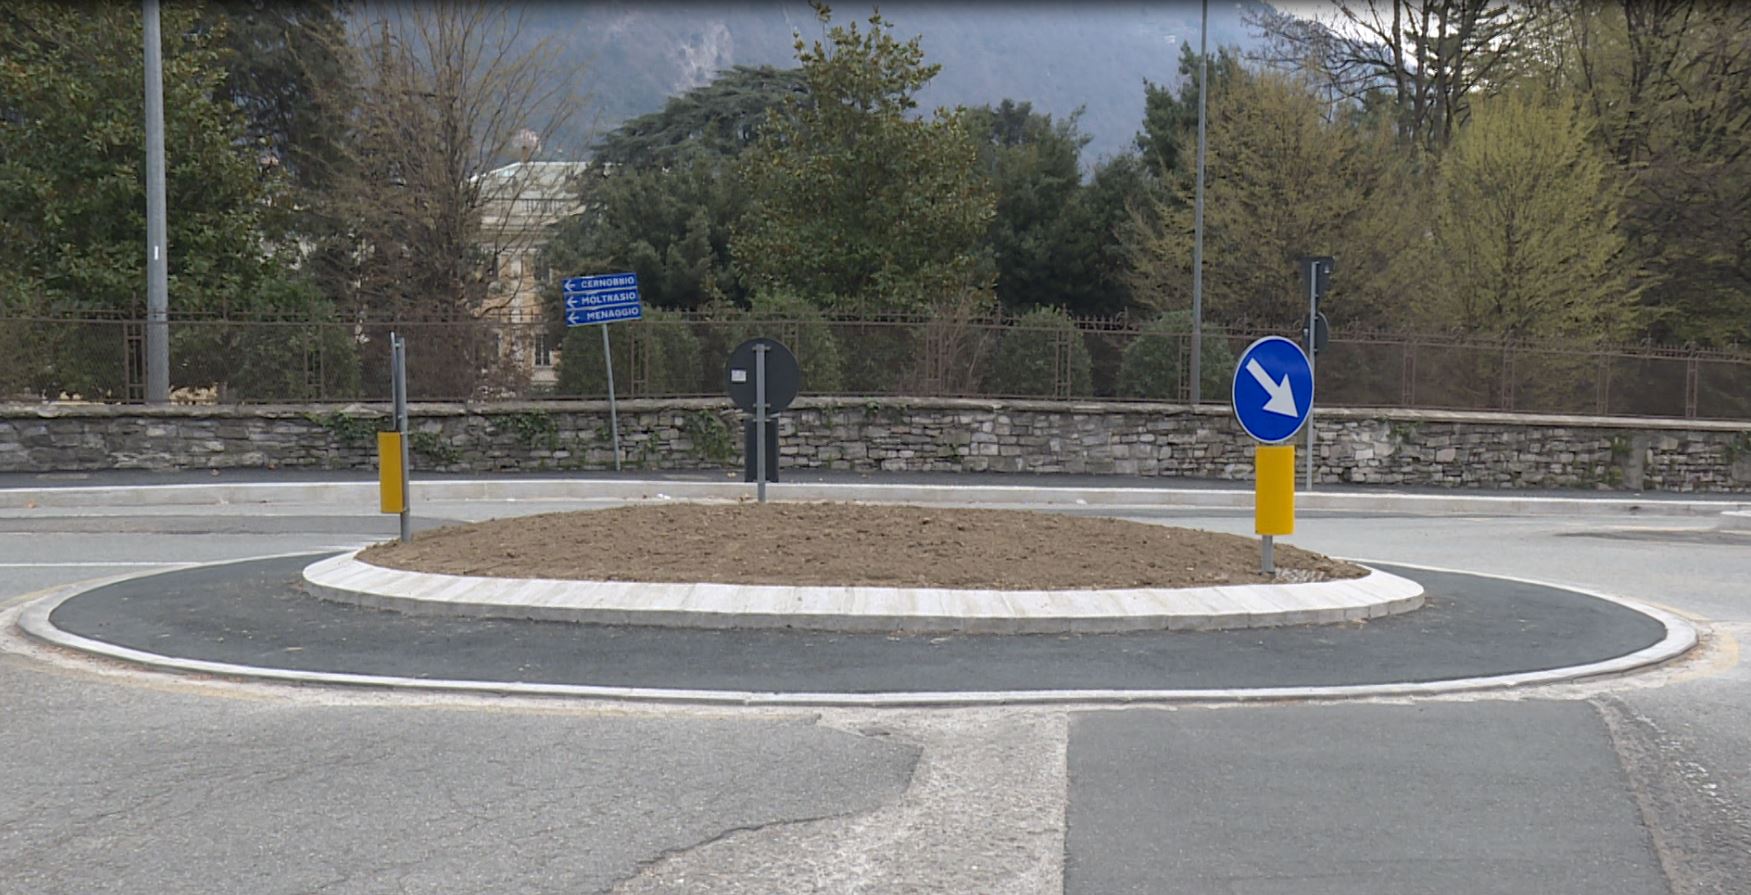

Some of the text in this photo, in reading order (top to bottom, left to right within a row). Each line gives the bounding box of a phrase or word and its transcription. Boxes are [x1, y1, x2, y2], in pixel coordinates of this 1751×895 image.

[581, 276, 635, 288] CERNOBBIO
[581, 292, 636, 305] MOLTRASIO
[587, 307, 639, 320] MENAGGIO
